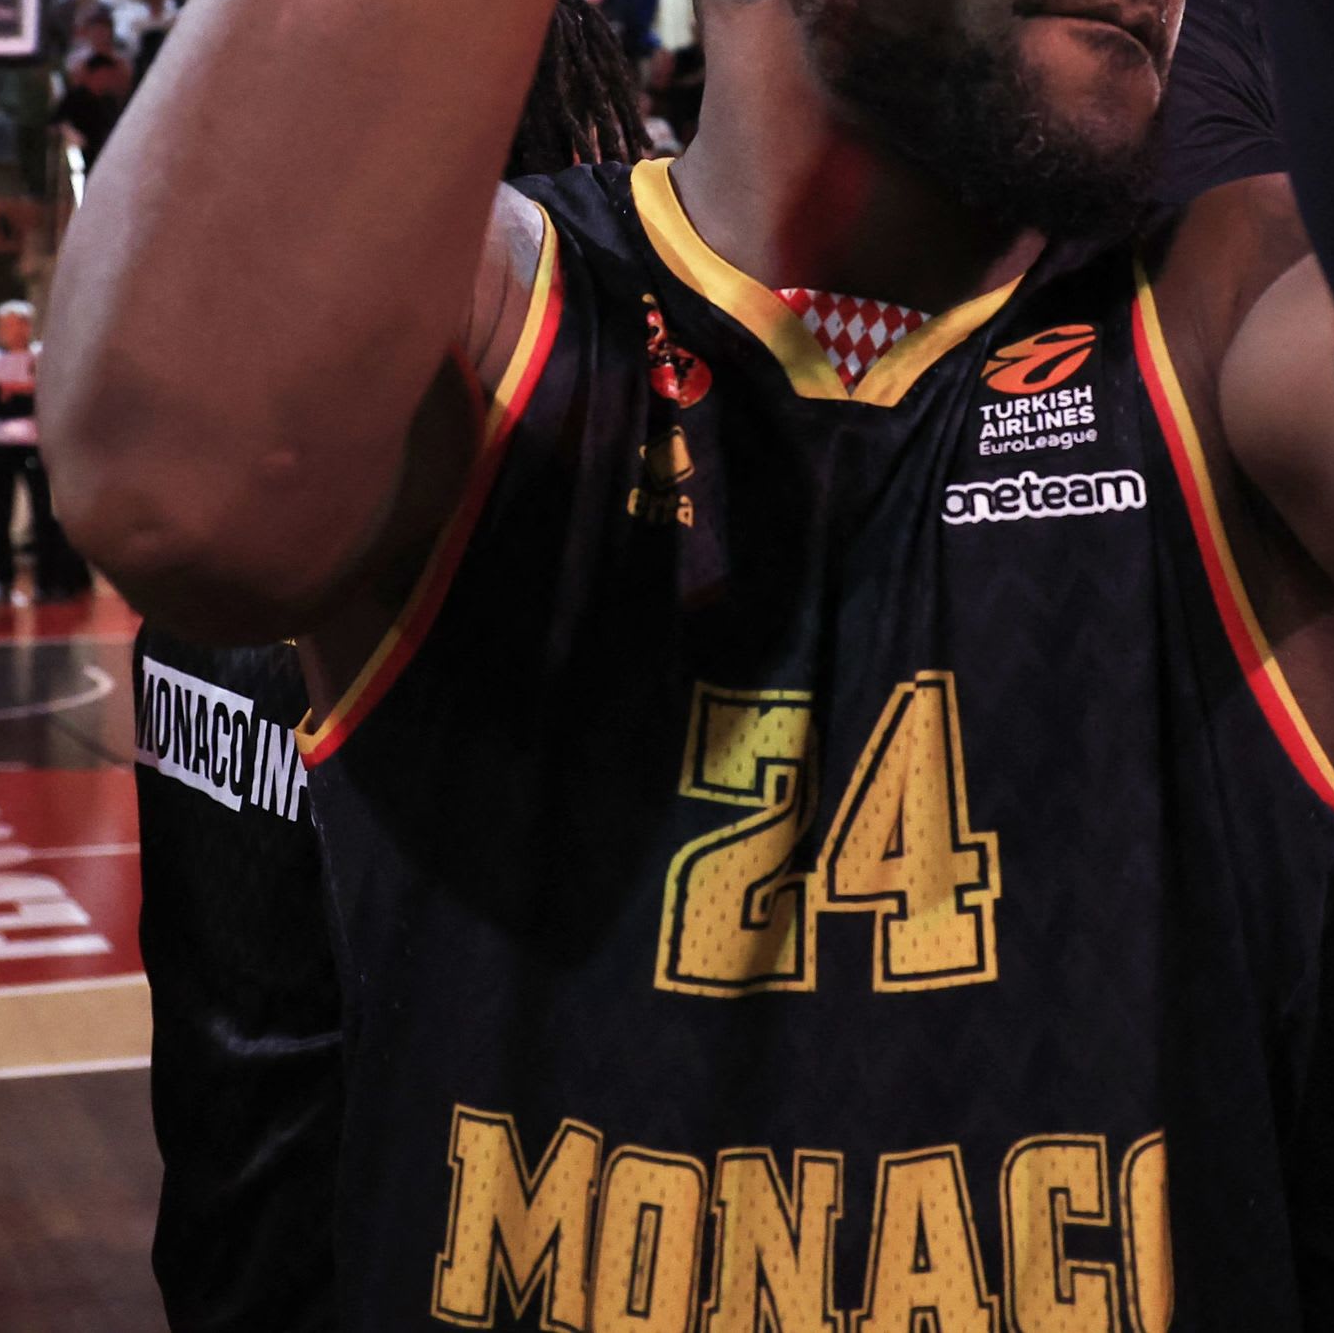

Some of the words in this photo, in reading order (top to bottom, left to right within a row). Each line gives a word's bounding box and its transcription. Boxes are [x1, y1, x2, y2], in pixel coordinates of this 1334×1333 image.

[979, 385, 1093, 421] TURKISH
[980, 405, 1095, 439] AIRLINES
[979, 429, 1097, 456] EuroLeague
[942, 469, 1147, 524] oneteam
[654, 670, 1001, 998] 24
